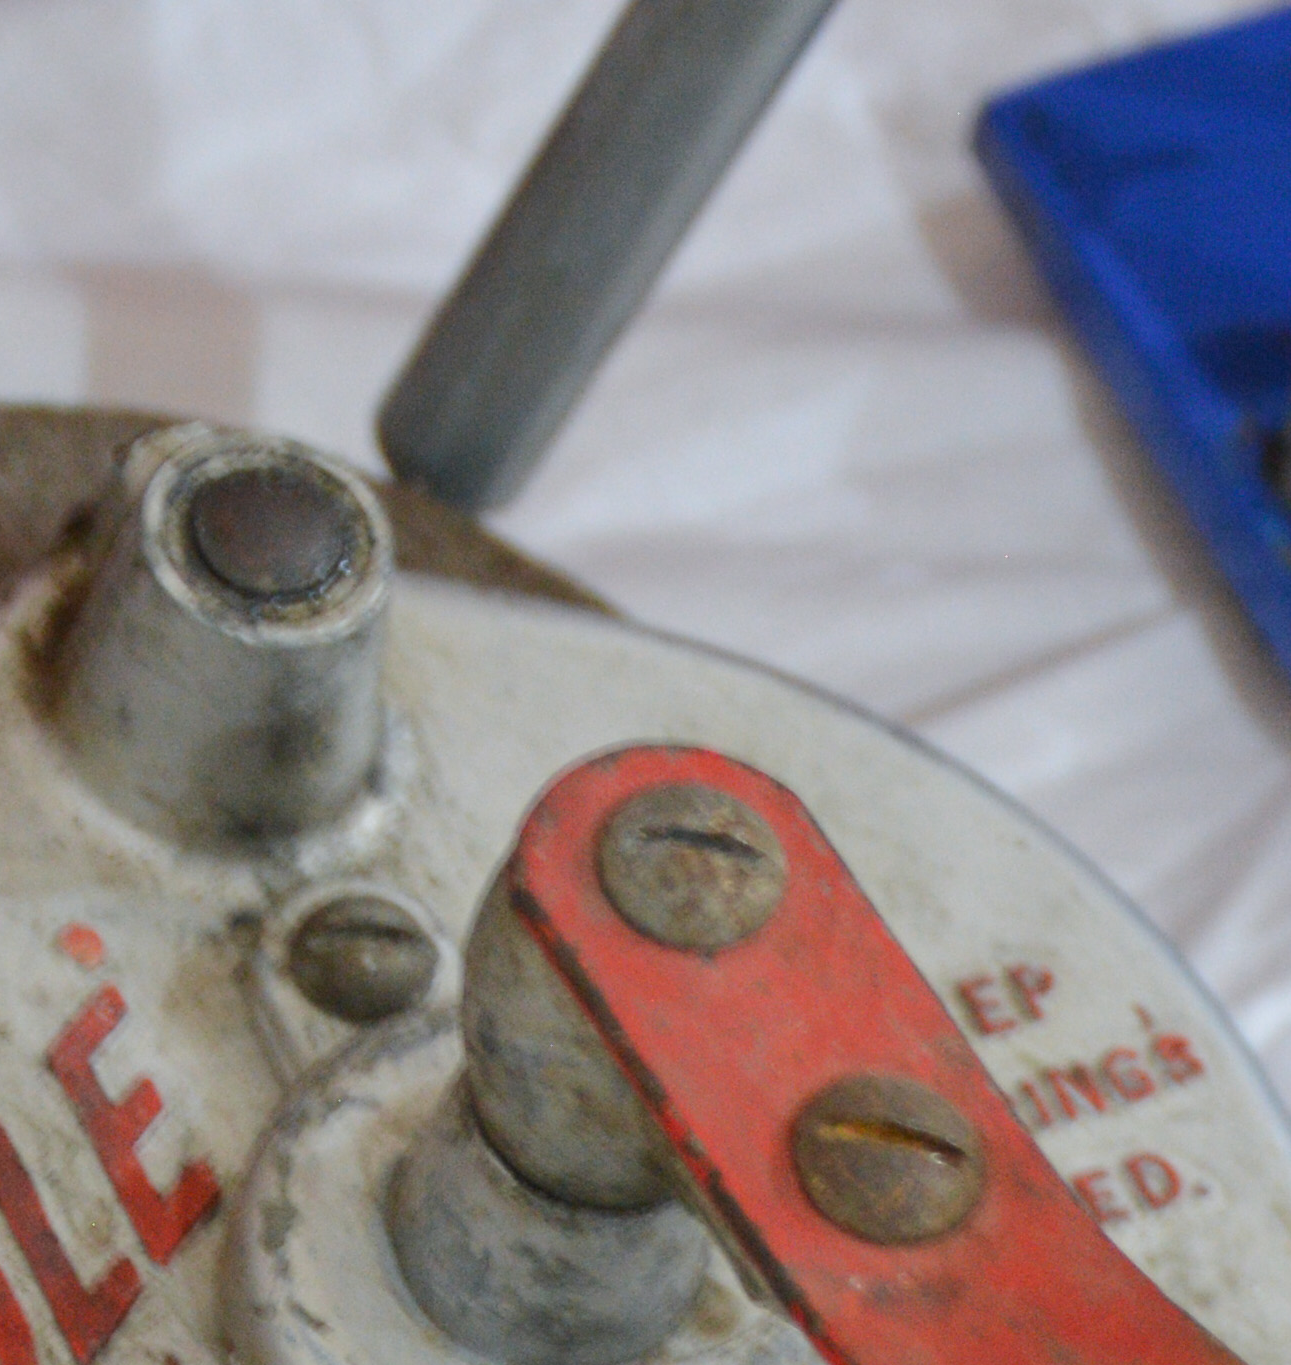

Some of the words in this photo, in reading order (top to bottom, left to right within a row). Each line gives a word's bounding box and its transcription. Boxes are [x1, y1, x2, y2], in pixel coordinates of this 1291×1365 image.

[954, 960, 1056, 1037] EP
[1016, 1001, 1206, 1129] ING'S
[1070, 1150, 1211, 1226] ED.
